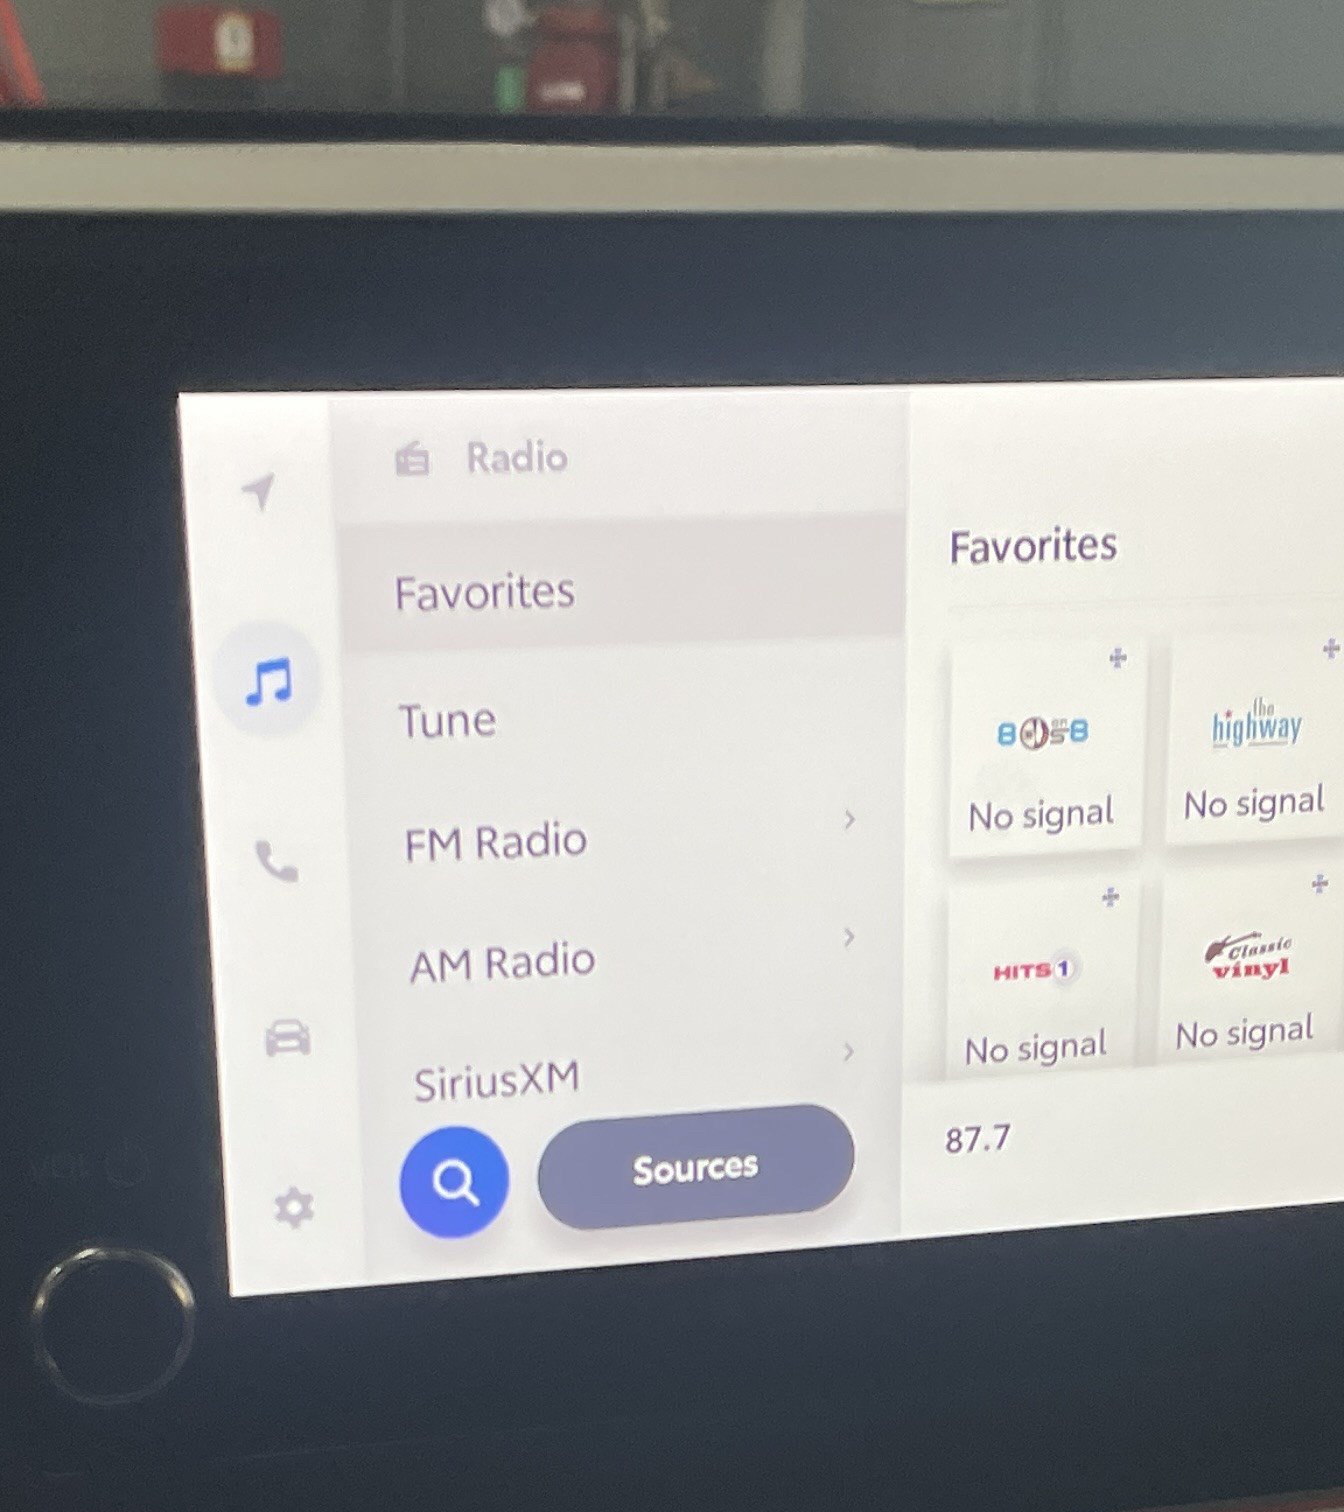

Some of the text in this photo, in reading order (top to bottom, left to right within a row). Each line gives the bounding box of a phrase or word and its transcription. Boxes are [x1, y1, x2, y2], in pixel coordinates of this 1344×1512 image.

[467, 438, 569, 475] Radio
[951, 525, 1118, 565] Favorites
[396, 571, 575, 612] Favorites
[399, 703, 496, 739] Tune
[1212, 709, 1302, 747] highway
[969, 794, 1114, 836] No signal
[1184, 782, 1325, 823] No signal
[406, 820, 587, 863] FM Radio
[409, 940, 596, 984] AM Radio
[993, 963, 1052, 981] HITS
[1212, 957, 1290, 980] vinyl
[965, 1027, 1107, 1068] No signal
[1176, 1012, 1314, 1052] No signal
[415, 1060, 580, 1103] SiriusXM
[945, 1123, 1011, 1155] 87.7
[633, 1154, 759, 1186] Sources
